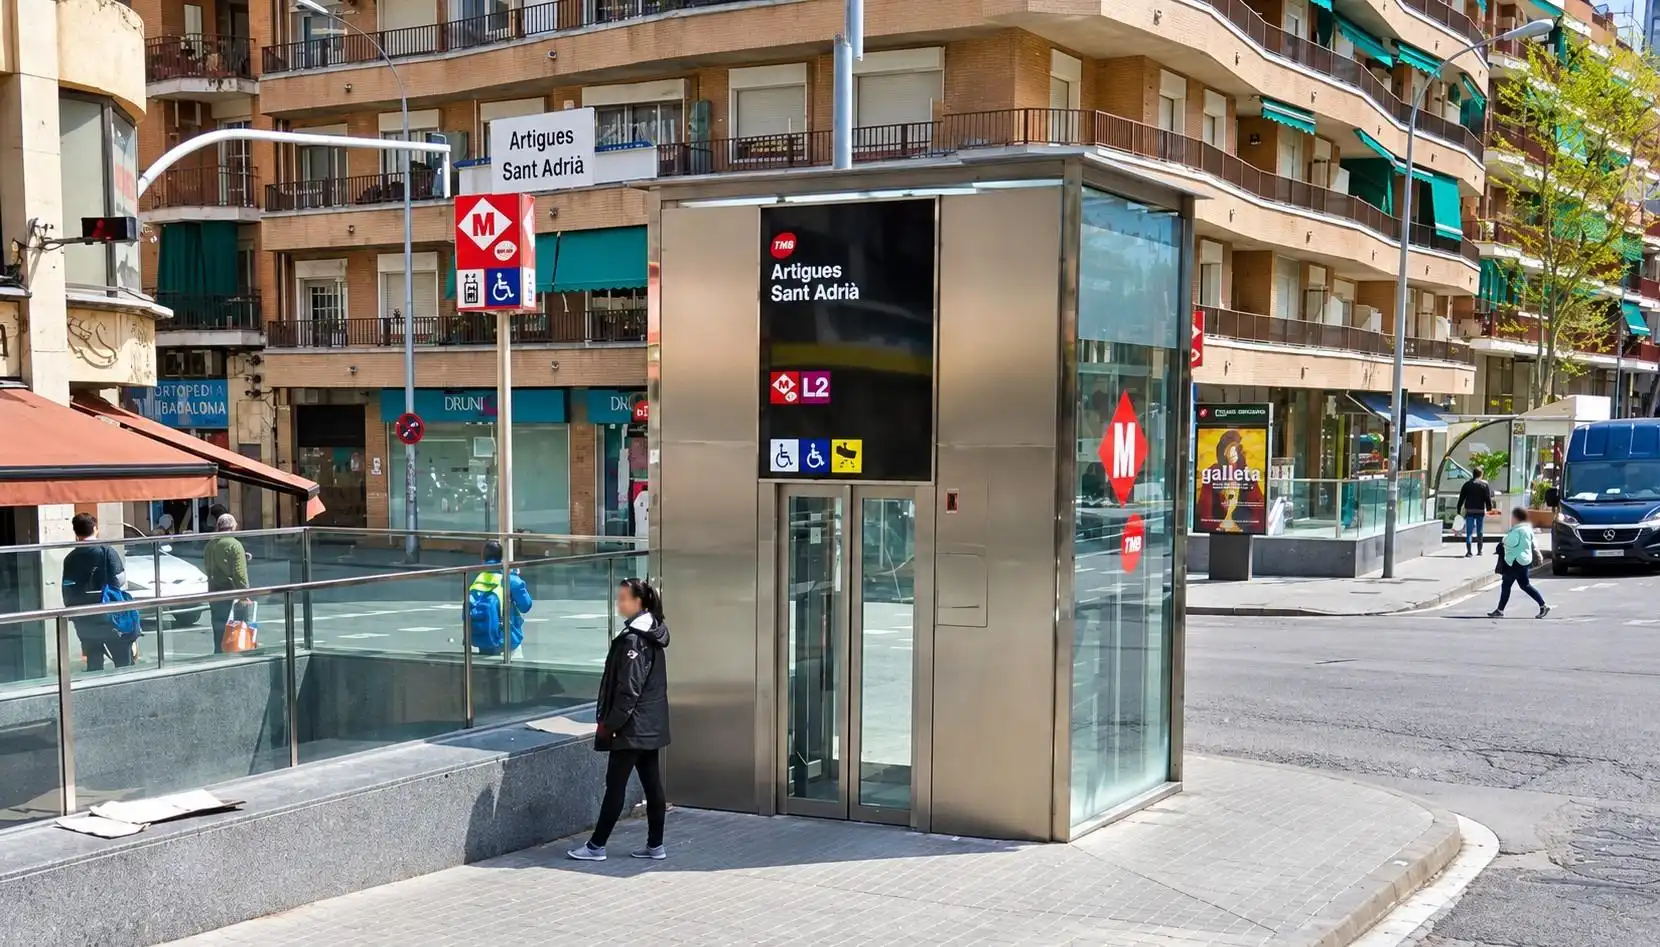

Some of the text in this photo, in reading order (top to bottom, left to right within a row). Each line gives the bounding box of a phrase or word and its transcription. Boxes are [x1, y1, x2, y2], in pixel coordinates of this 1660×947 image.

[509, 129, 574, 152] Artigues
[502, 155, 585, 181] Sant Adrià
[472, 211, 495, 237] M
[775, 240, 795, 250] TMB
[771, 262, 842, 283] Artigues
[771, 282, 859, 302] Sant Adrià
[803, 376, 829, 398] L2
[1113, 421, 1136, 479] M
[1201, 464, 1260, 484] galleta
[1124, 535, 1142, 554] TMB
